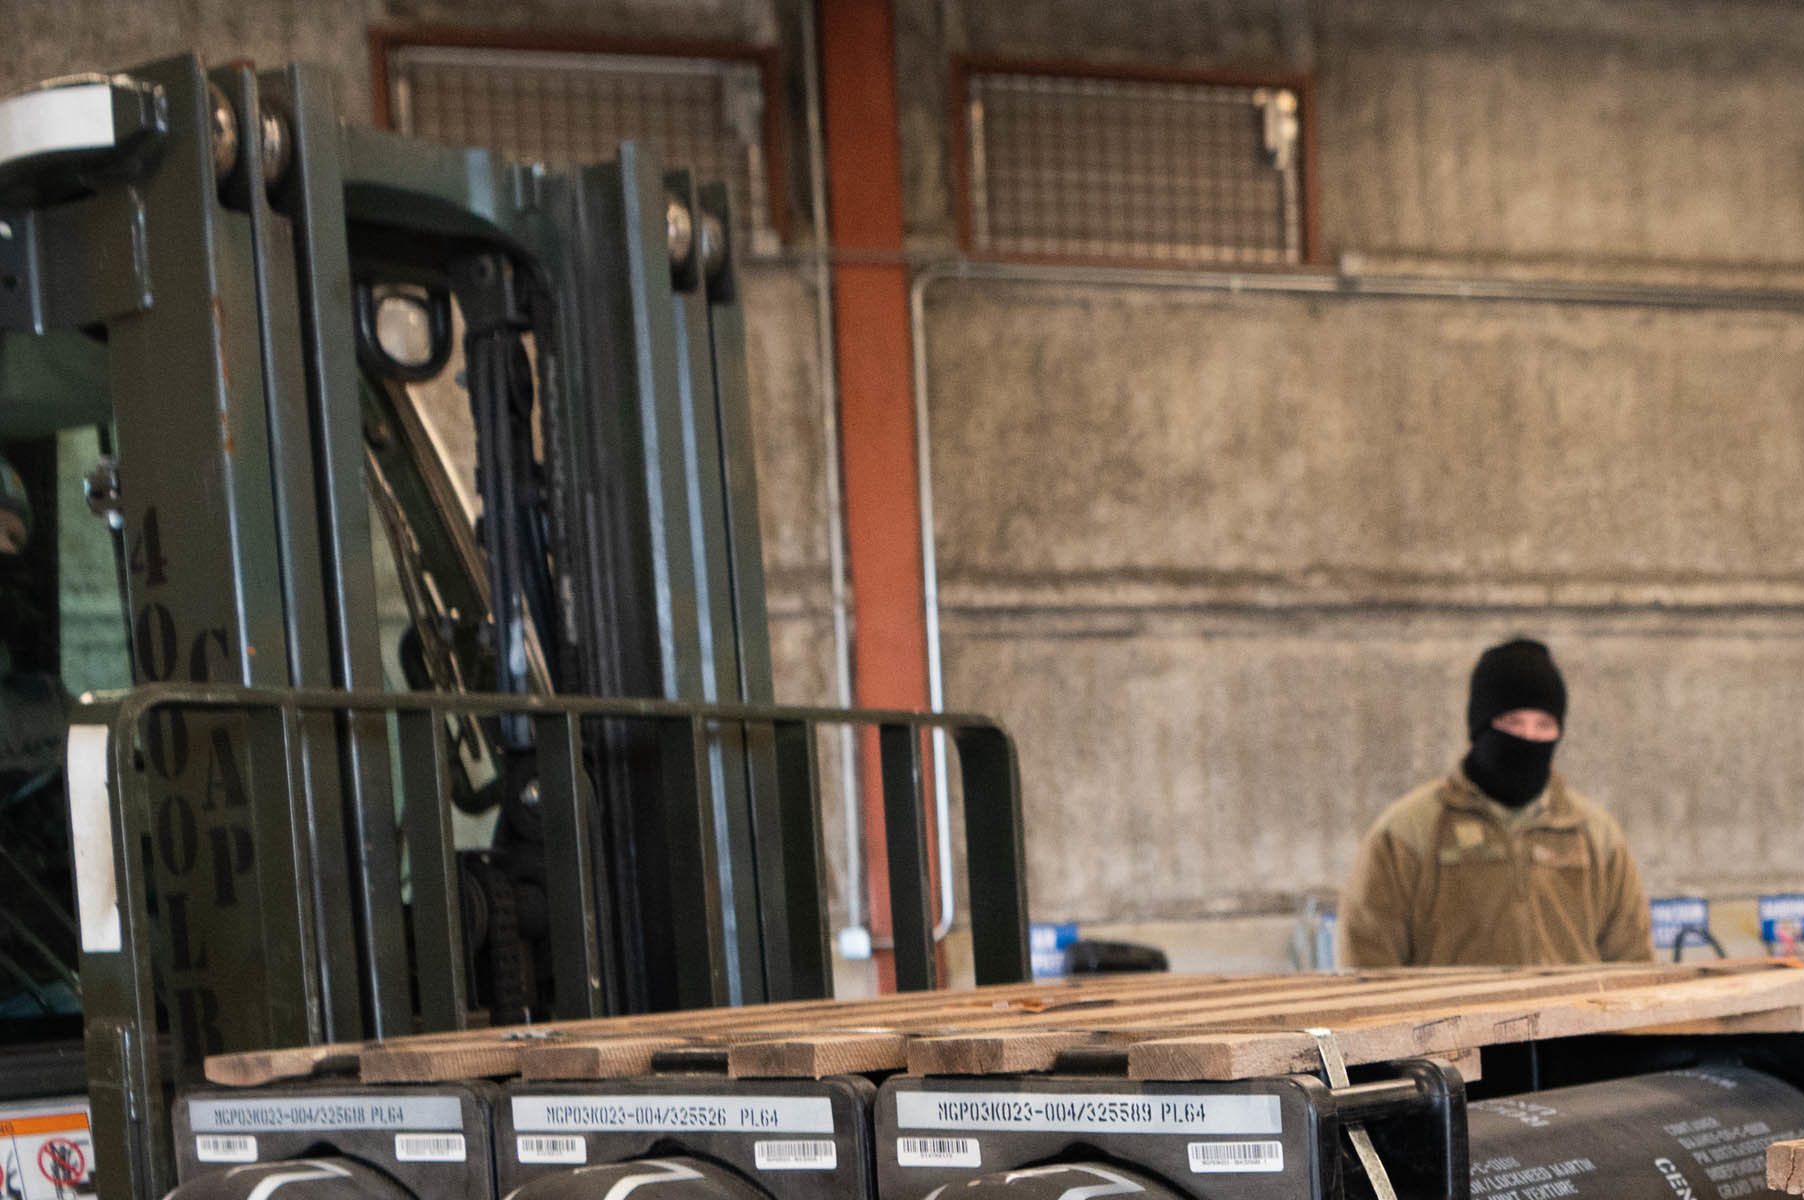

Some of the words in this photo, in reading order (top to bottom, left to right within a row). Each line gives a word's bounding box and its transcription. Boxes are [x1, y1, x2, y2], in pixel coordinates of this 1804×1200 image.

[546, 1105, 727, 1127] MGP03K023-004/325526
[740, 1107, 778, 1127] PL64
[937, 1100, 1153, 1123] MGP03K023-004/325589
[1160, 1102, 1206, 1123] PL64
[1548, 1157, 1597, 1178] MARTIN
